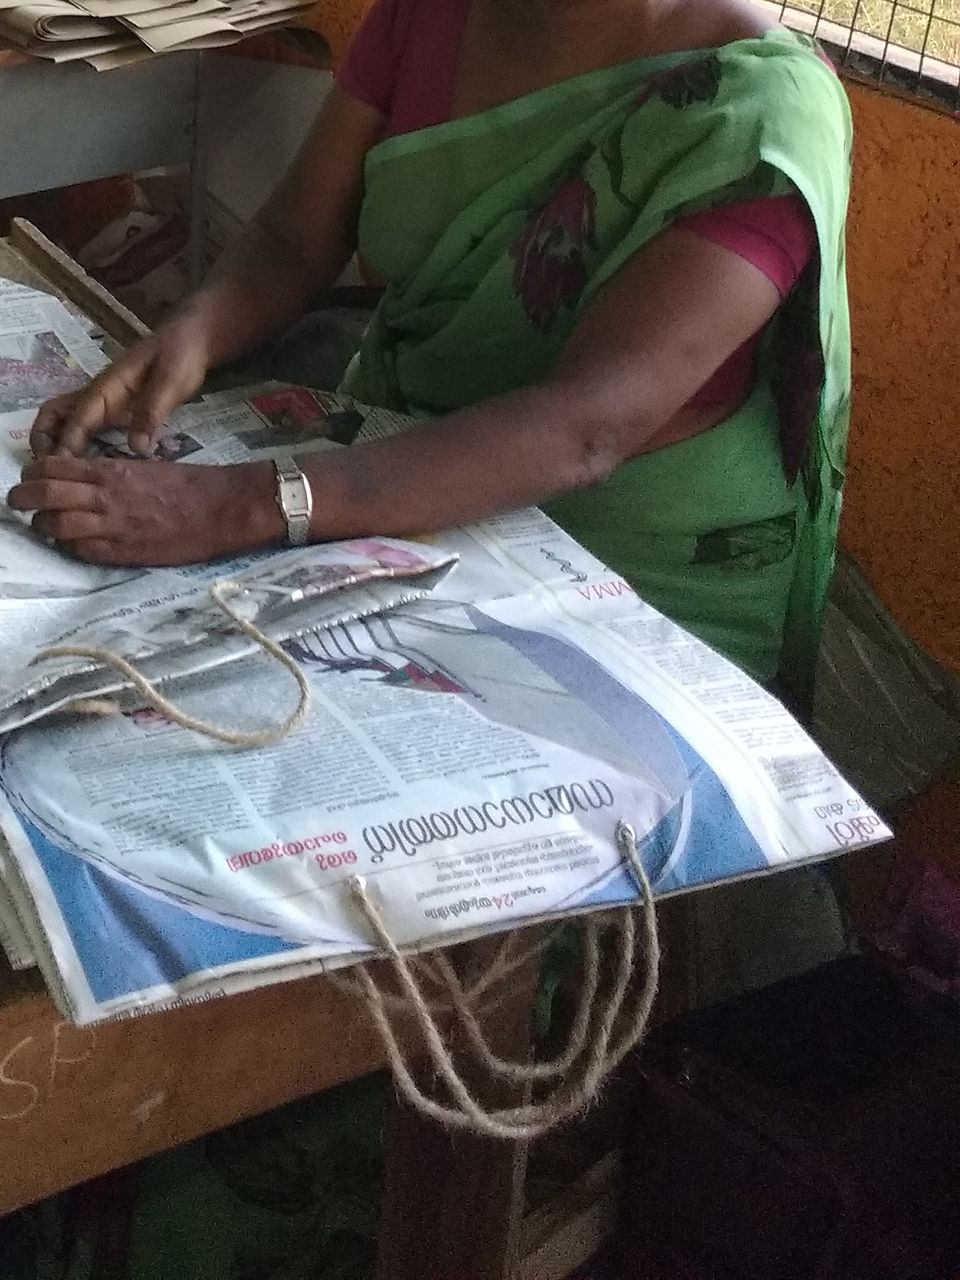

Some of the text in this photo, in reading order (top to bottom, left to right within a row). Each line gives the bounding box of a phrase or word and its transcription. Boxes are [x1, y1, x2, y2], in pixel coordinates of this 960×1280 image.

[361, 778, 614, 865] സമാധാനത്തിന്
[226, 830, 348, 873] പൊതുവേദി
[315, 849, 358, 872] ഒരു
[492, 894, 516, 911] 24
